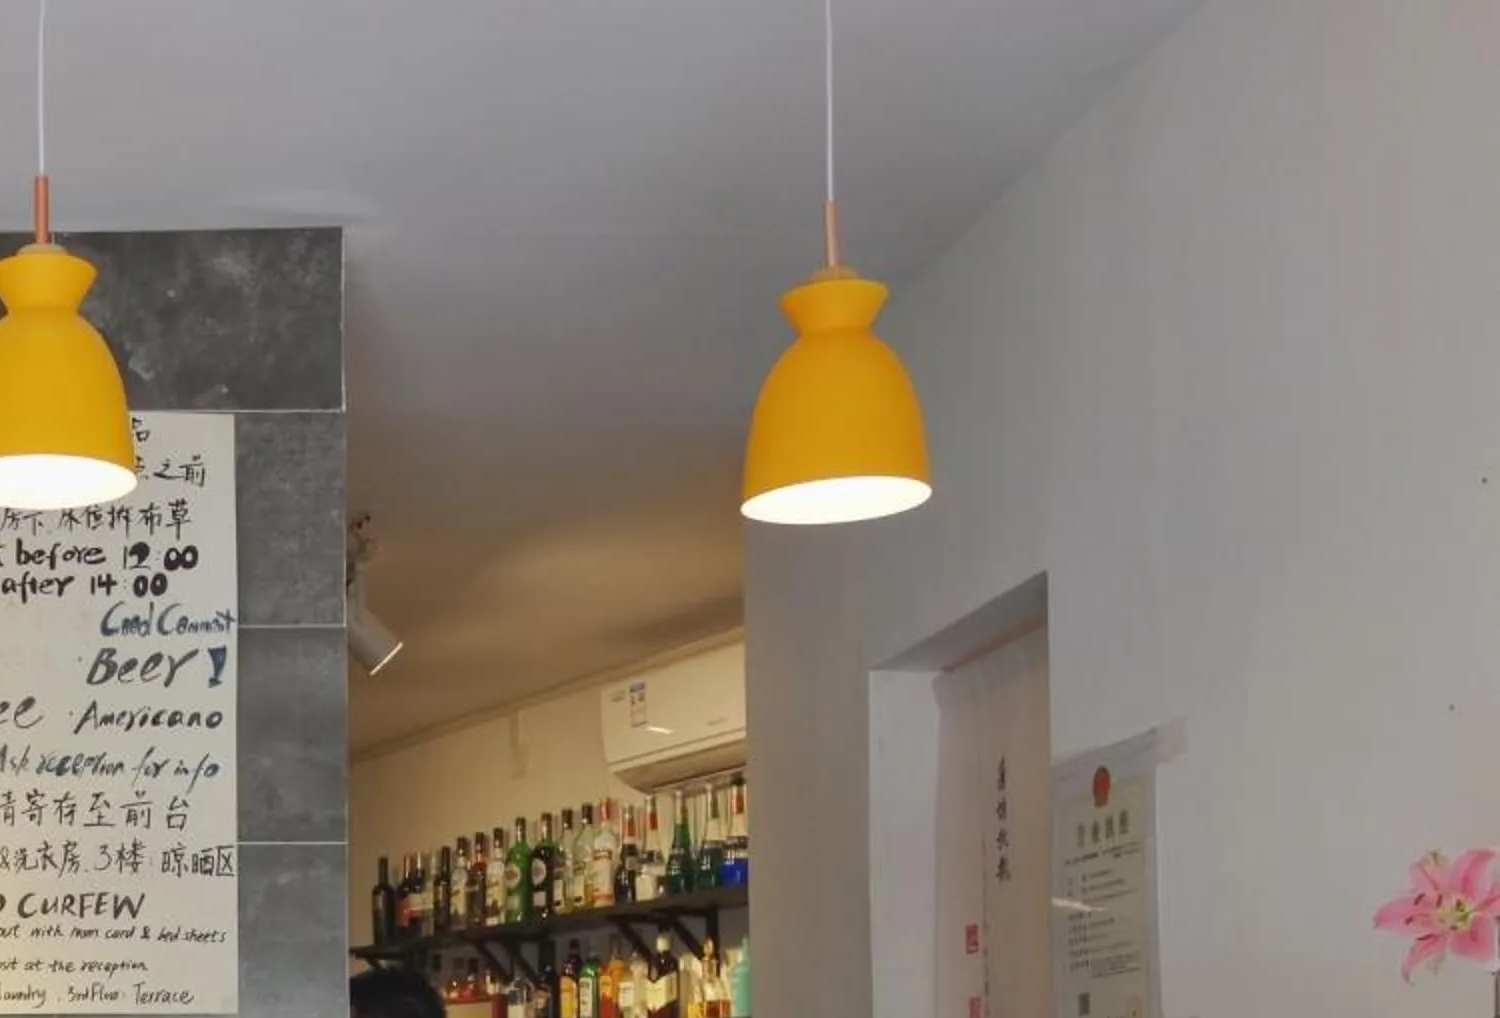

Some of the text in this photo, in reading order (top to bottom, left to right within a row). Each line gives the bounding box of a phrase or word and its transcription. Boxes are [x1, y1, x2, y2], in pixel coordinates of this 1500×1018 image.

[16, 538, 106, 571] before
[1, 571, 75, 605] after
[74, 700, 224, 735] Americano
[18, 892, 145, 920] CURFEW
